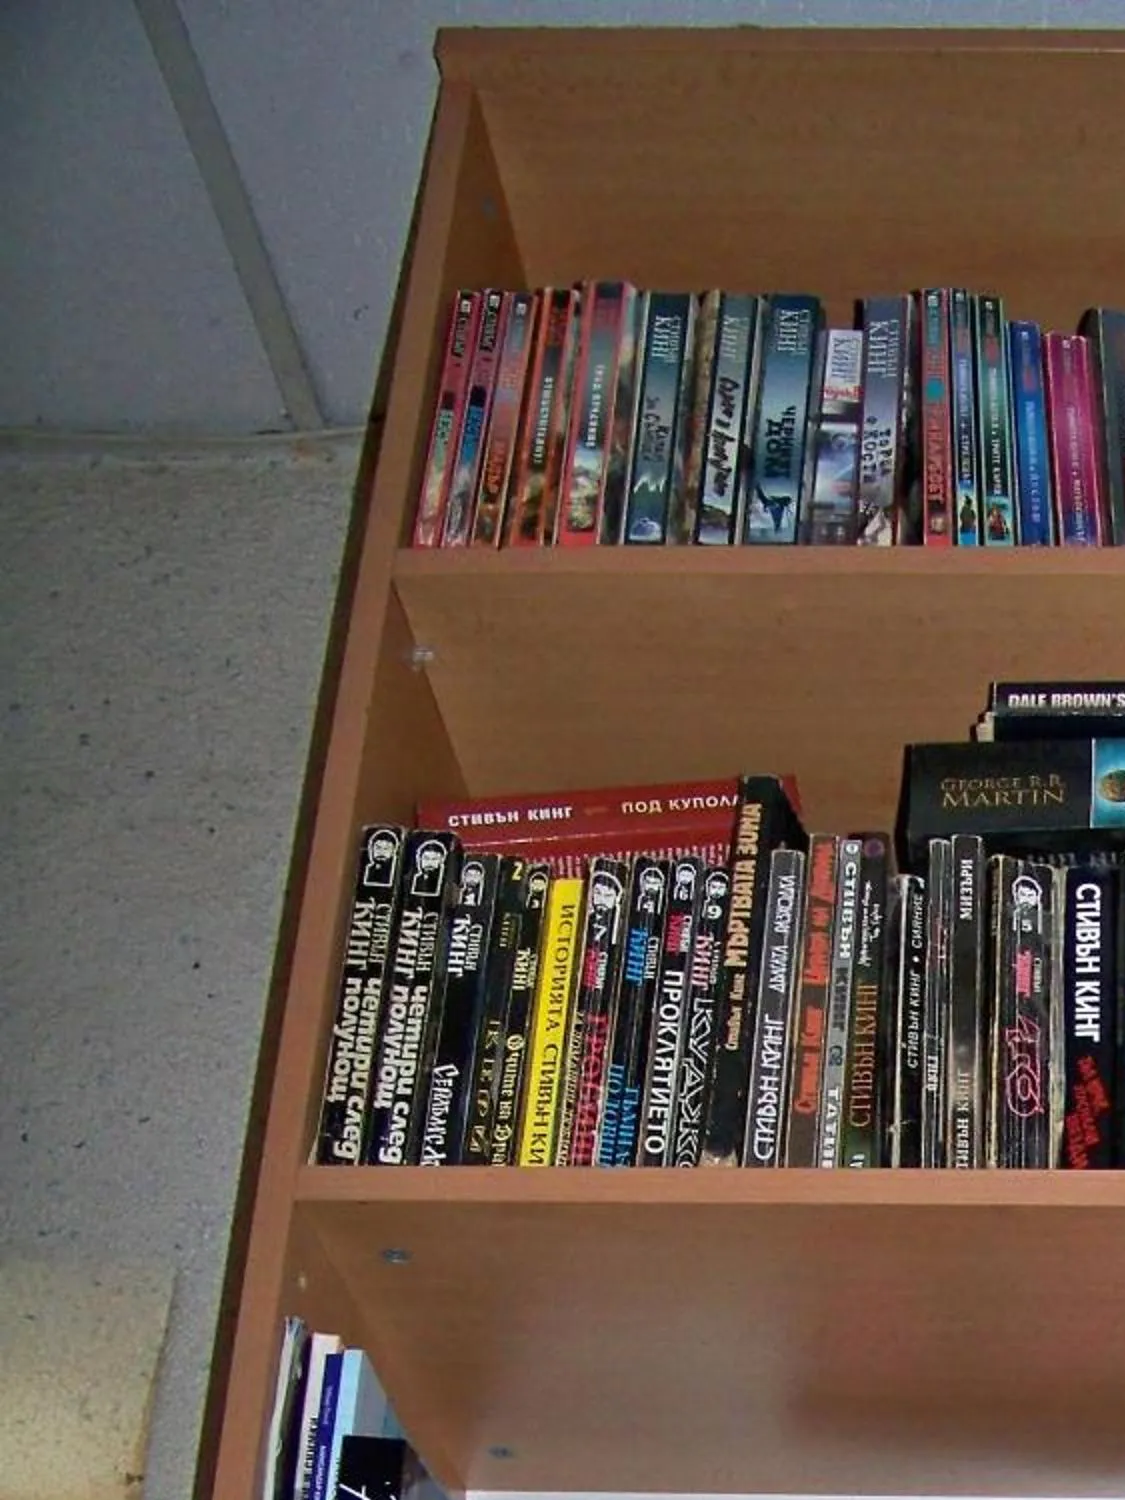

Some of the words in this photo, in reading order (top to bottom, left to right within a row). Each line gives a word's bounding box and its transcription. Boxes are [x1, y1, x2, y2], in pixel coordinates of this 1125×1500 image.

[1008, 691, 1047, 709] DALE
[447, 810, 519, 828] СТИВЪН
[526, 805, 574, 823] КИНГ
[621, 798, 663, 816] ПОД
[940, 776, 1022, 792] GEORGE
[942, 788, 1065, 809] MARTIN
[737, 802, 763, 856] ЗОНА
[723, 860, 756, 967] МЪРТВАТА
[838, 861, 860, 959] СТИВЪН
[958, 858, 975, 921] МИЗЪРИ
[345, 896, 378, 971] КИНГ
[367, 903, 394, 964] СТИВЪН
[394, 905, 426, 980] КИНГ
[416, 911, 440, 972] СТИВЪН
[446, 914, 473, 978] КИНГ
[910, 894, 923, 950] СИЯНИЕ
[1074, 883, 1102, 974] СТИВЪН
[545, 903, 578, 1033] ИСТОРИЯТА
[909, 970, 922, 1008] КИНГ
[350, 977, 386, 1087] четири
[396, 984, 433, 1094] четири
[855, 979, 880, 1036] КИНГ
[1074, 980, 1101, 1042] КИНГ
[327, 977, 365, 1103] полунощ
[374, 983, 412, 1109] полунощ
[644, 970, 684, 1155] ПРОКЛЯТИЕТО
[760, 1012, 786, 1070] КИНГ
[905, 1011, 921, 1070] СТИВЪН
[533, 1043, 560, 1127] СТИВЪН
[850, 1041, 877, 1128] СТИВЪН
[333, 1095, 370, 1160] след
[379, 1100, 416, 1164] след
[753, 1073, 780, 1161] СТИВЪН
